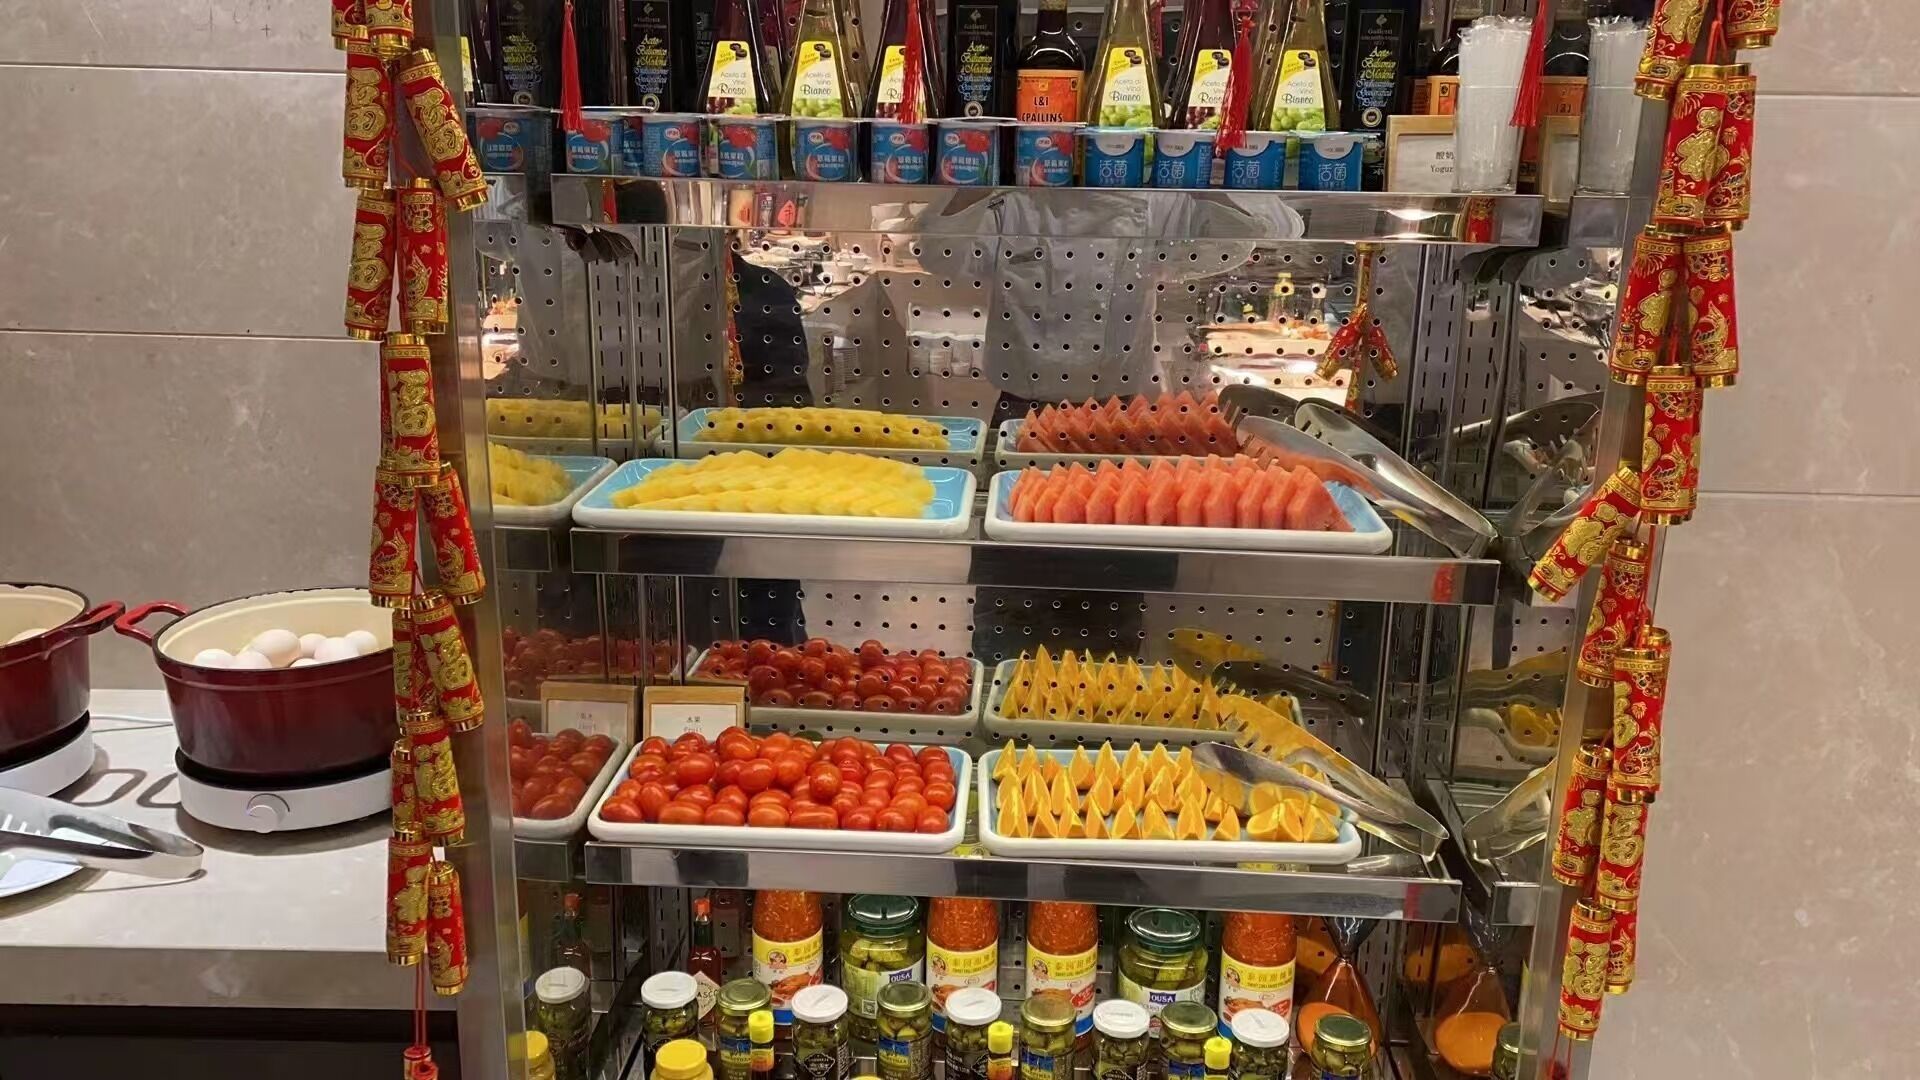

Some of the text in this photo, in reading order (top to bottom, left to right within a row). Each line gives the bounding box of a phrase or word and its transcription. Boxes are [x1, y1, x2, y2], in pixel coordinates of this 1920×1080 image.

[800, 84, 832, 95] Bianco
[1110, 90, 1141, 102] Bianco
[1282, 94, 1314, 104] Bianco
[1099, 160, 1128, 178] 活菌
[1160, 160, 1184, 178] 活菌
[1232, 160, 1260, 178] 活菌
[1318, 163, 1347, 182] 活菌
[1430, 164, 1454, 174] Yogur
[891, 972, 911, 982] OUSA
[1151, 994, 1174, 1003] OUSA
